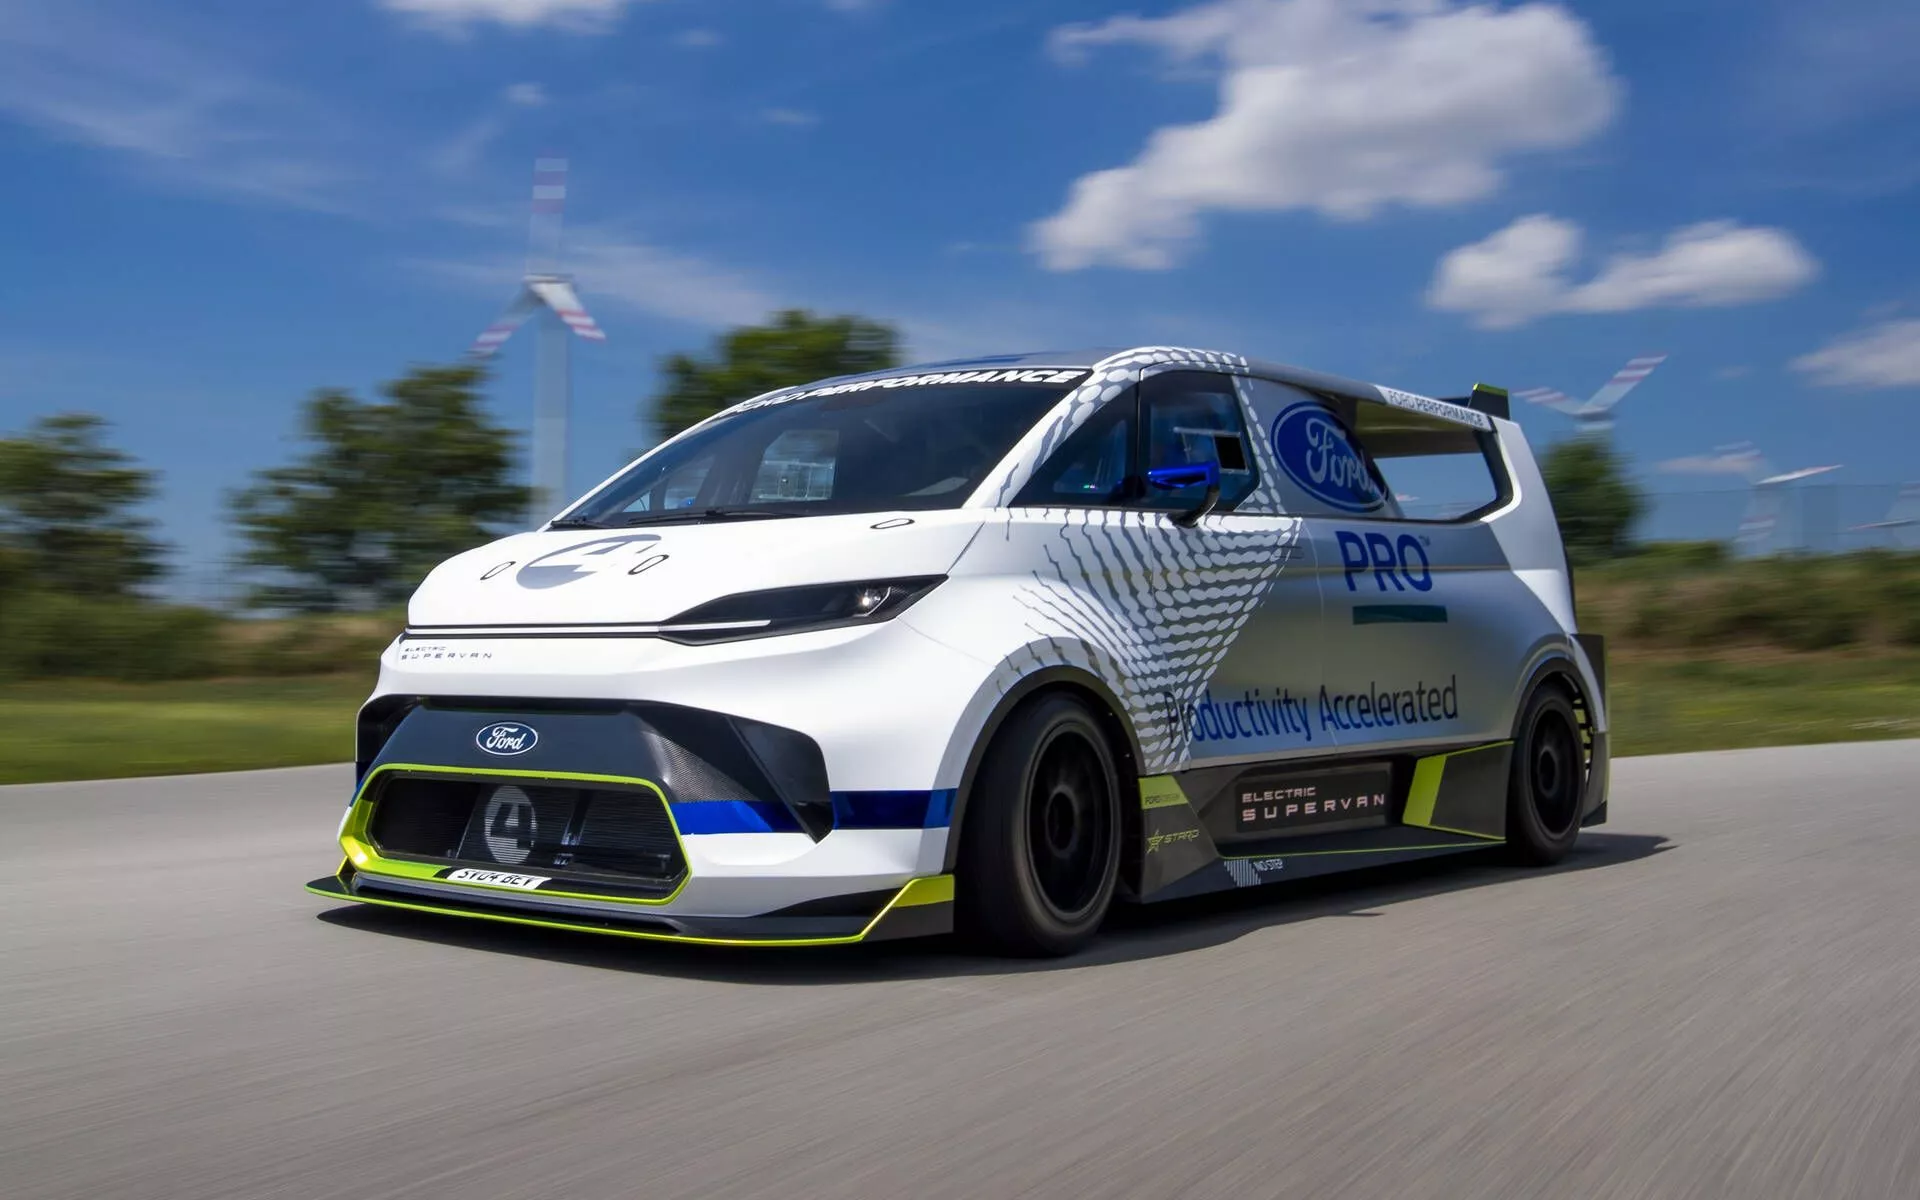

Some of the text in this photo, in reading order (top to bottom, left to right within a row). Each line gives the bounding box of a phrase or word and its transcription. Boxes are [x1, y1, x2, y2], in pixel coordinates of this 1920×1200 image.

[797, 370, 1085, 400] PERFORMANCE
[1415, 397, 1485, 427] PERFORMANCE
[1306, 417, 1378, 493] Ford
[401, 652, 493, 660] SUPERVAN
[1164, 674, 1460, 743] Productivity Accelerated
[486, 726, 527, 750] Ford
[1242, 786, 1317, 803] ELECTRIC
[1242, 794, 1385, 822] SUPERVAN
